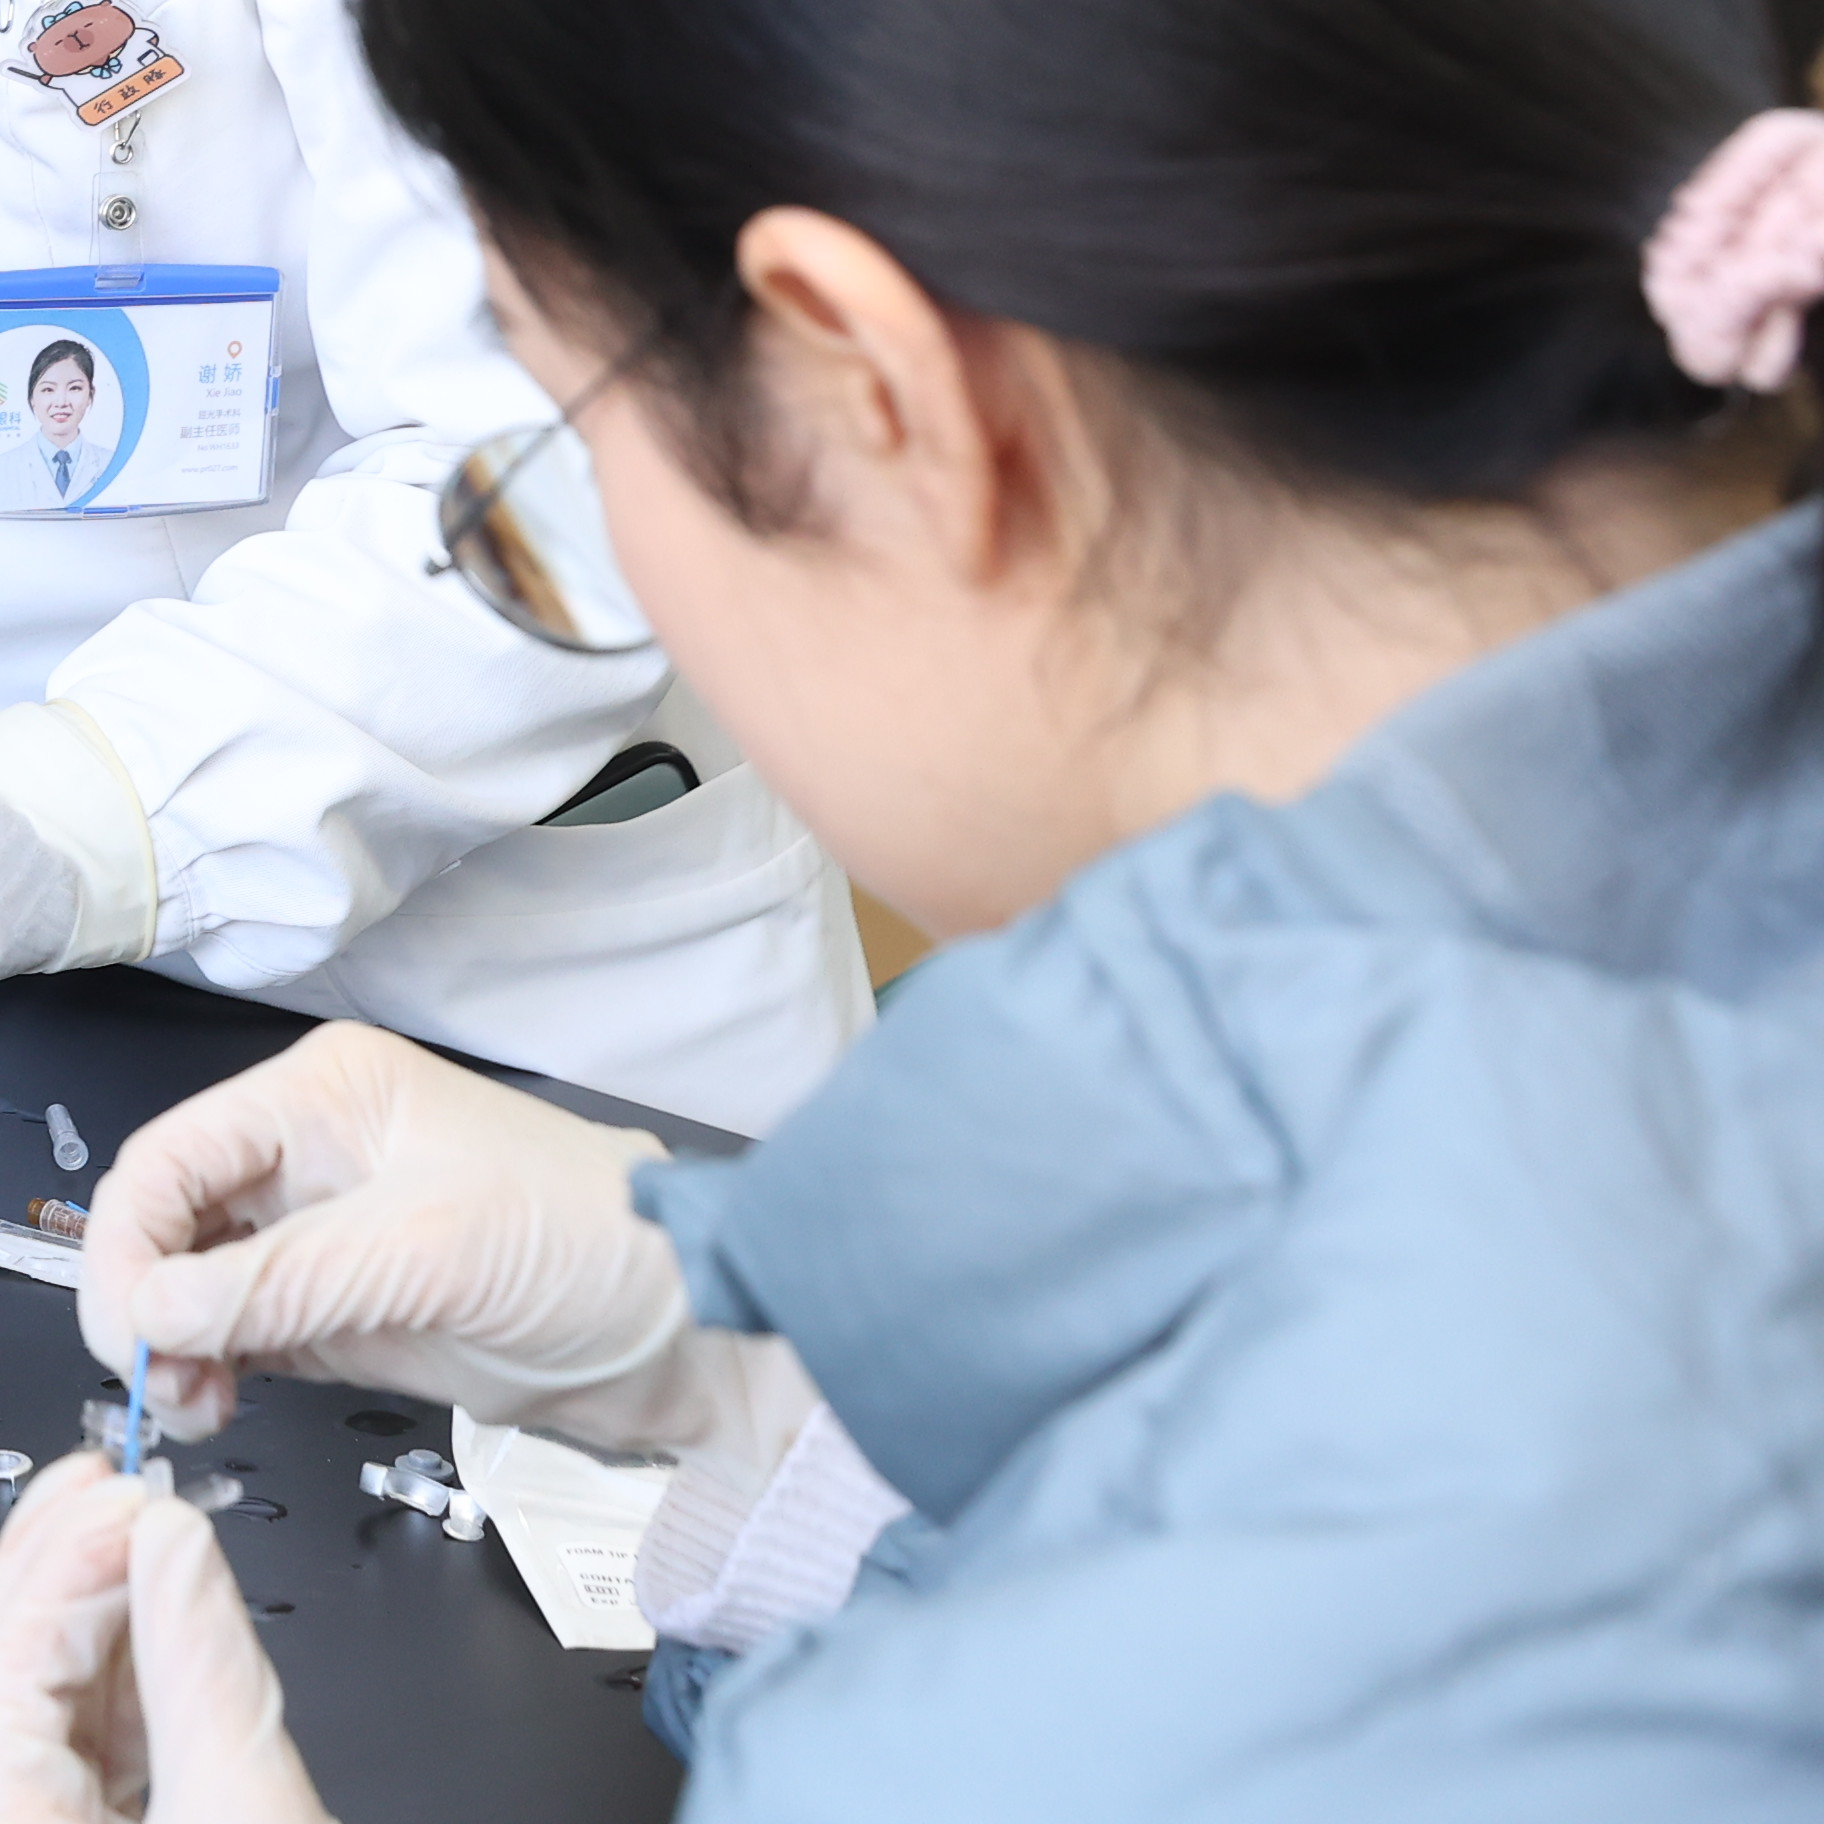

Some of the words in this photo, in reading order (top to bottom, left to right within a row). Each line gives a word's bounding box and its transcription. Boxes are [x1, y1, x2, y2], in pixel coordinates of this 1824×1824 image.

[180, 422, 241, 439] 副主任医师
